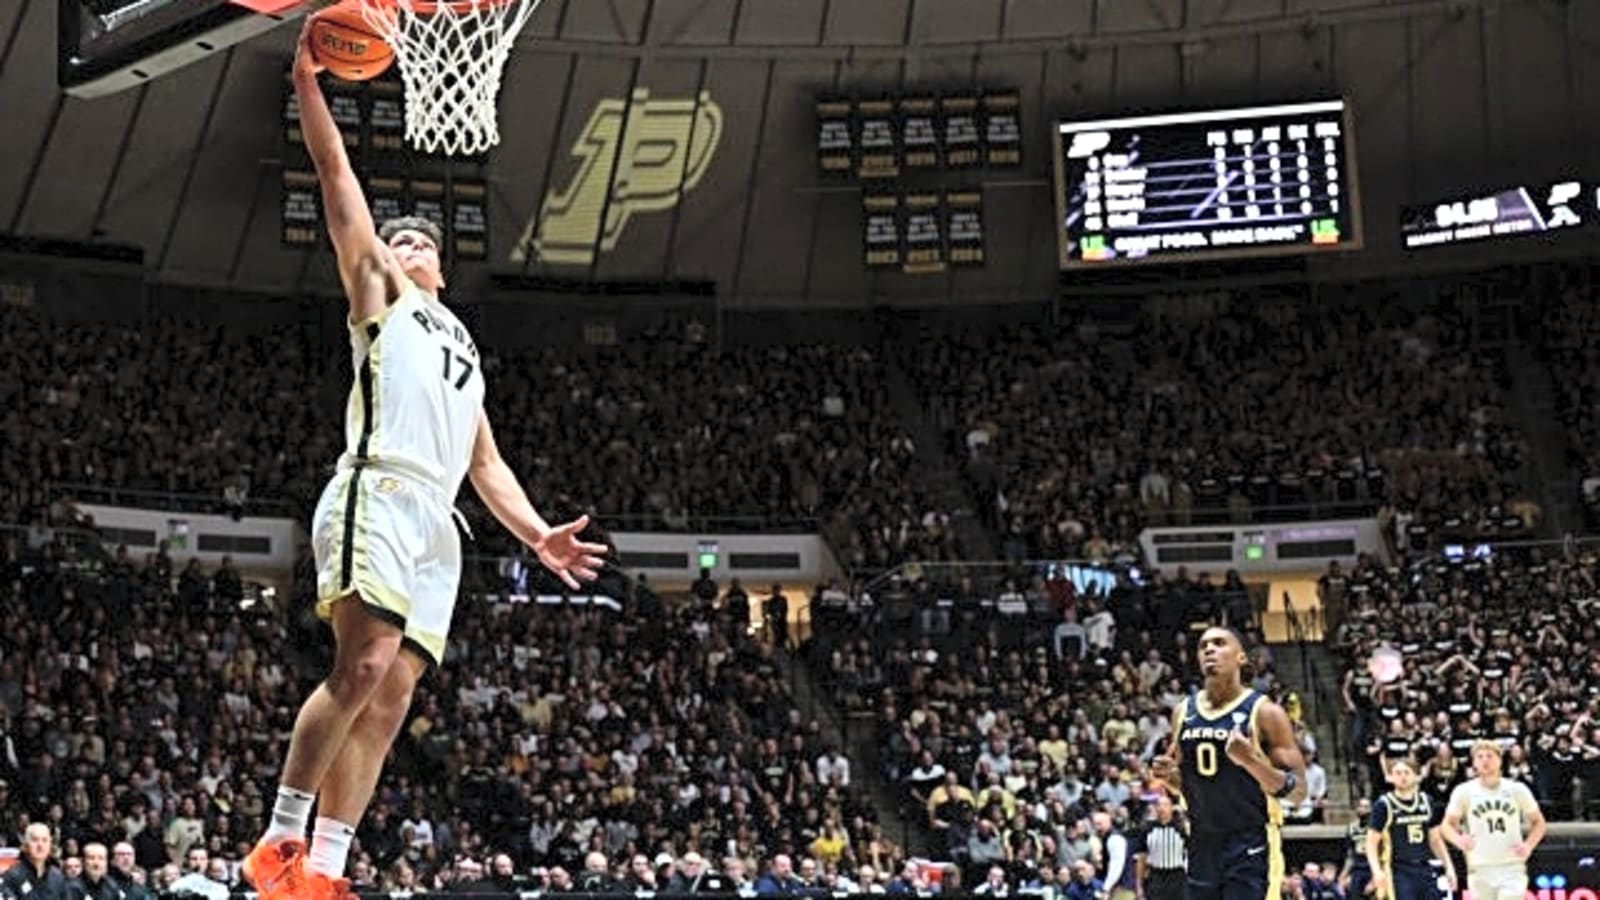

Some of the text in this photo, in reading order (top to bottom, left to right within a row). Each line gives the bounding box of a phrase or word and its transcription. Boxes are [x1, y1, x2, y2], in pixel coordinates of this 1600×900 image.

[441, 345, 473, 391] 17
[1181, 727, 1229, 741] AKRO
[1196, 742, 1217, 776] 0
[1407, 824, 1424, 844] 15
[1486, 816, 1506, 834] 14
